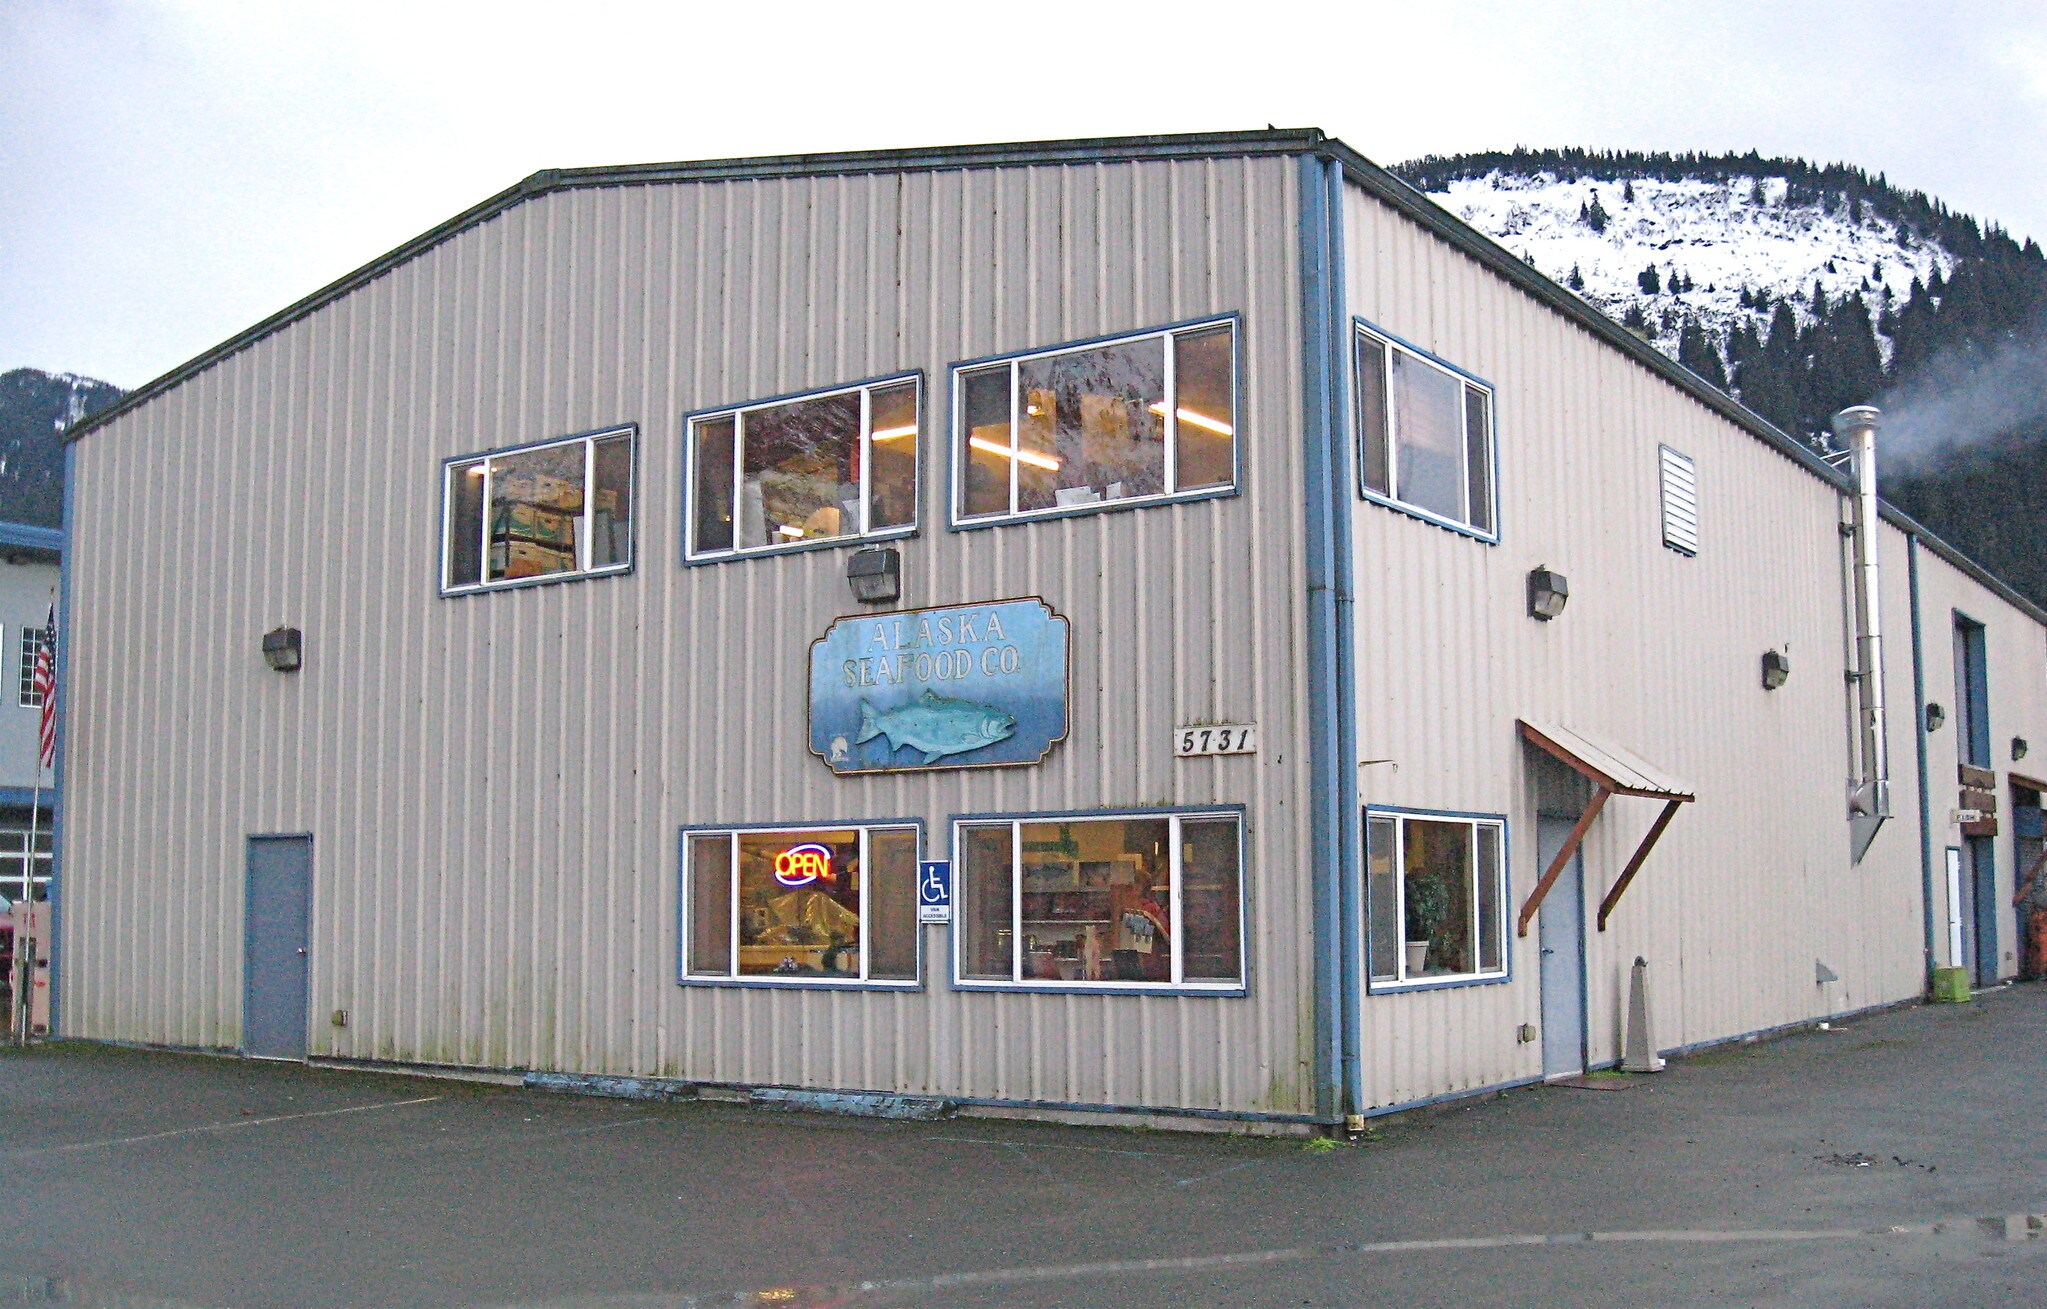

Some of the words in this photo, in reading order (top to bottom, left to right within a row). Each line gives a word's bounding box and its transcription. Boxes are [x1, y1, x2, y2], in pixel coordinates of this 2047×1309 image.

[868, 611, 1006, 652] ALASKA
[842, 649, 972, 688] SEAFOOD
[1182, 729, 1248, 752] 5731
[775, 852, 828, 877] OPEN
